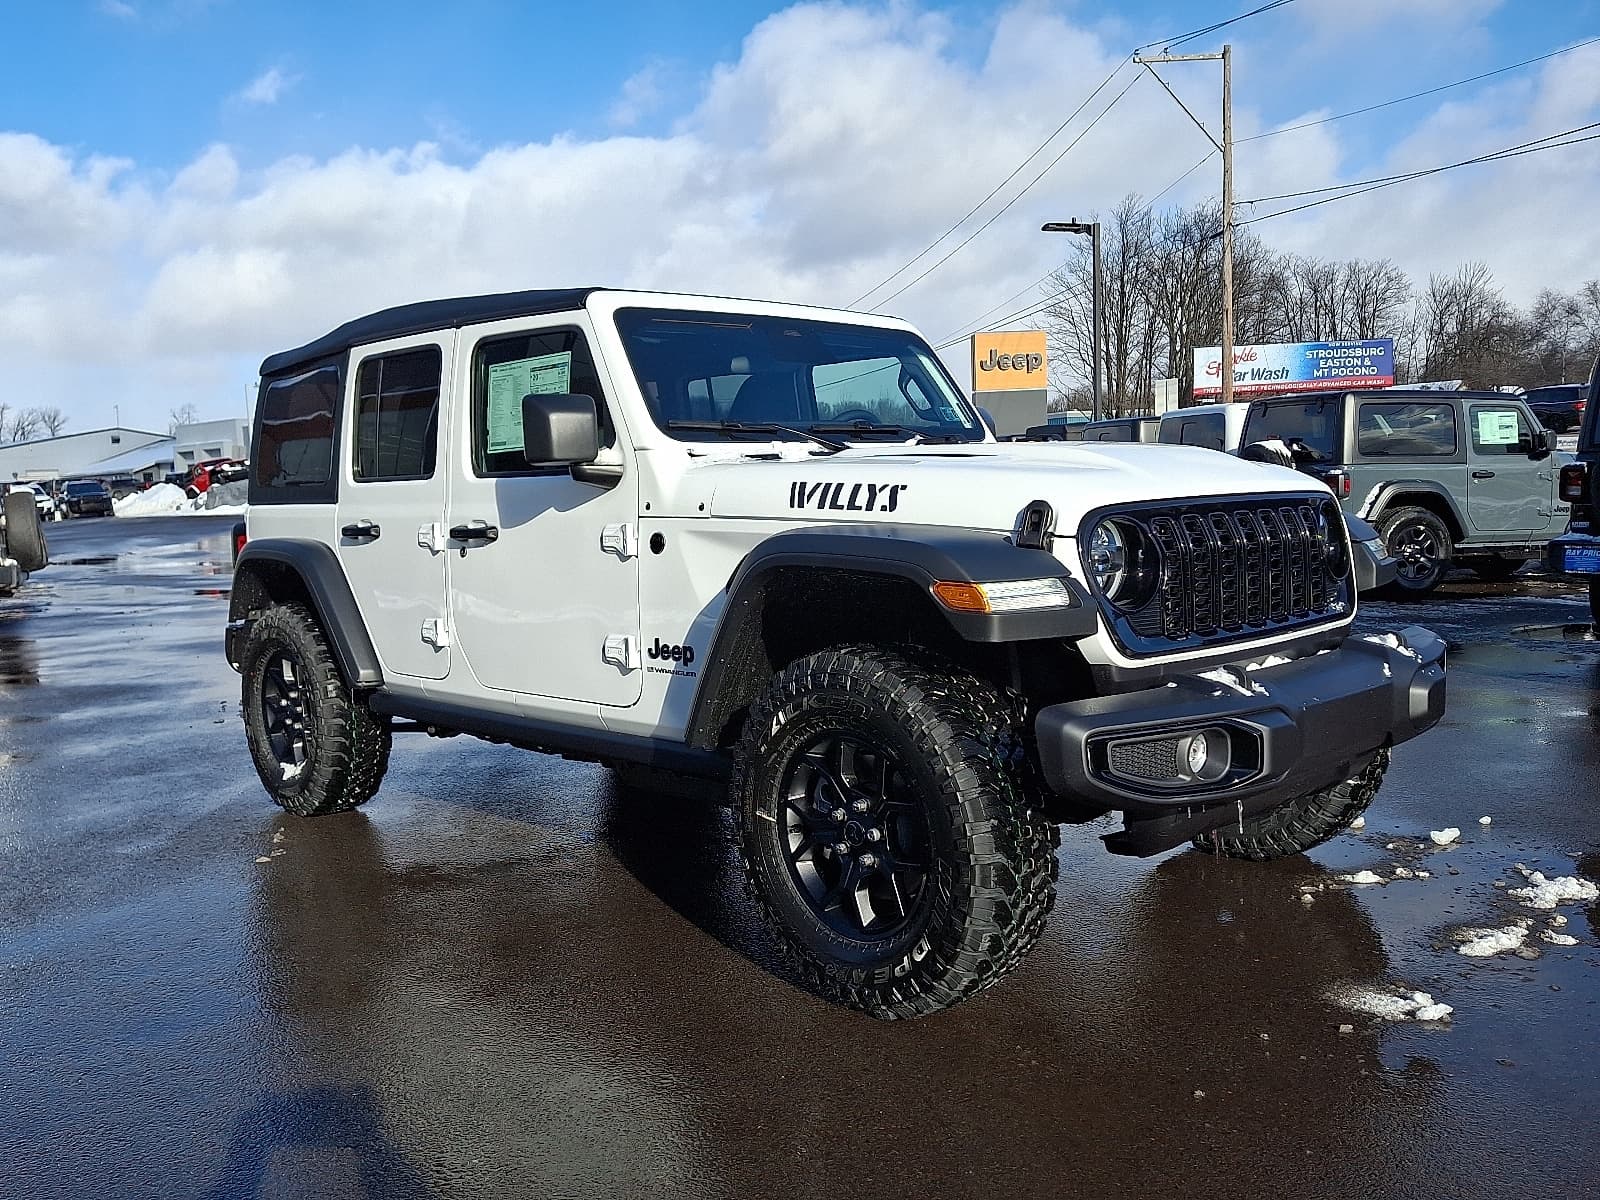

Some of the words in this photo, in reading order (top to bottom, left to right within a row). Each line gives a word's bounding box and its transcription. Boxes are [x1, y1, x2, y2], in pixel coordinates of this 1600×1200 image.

[1306, 347, 1385, 359] STROUDSBURG
[980, 348, 1043, 374] Jeep
[1319, 358, 1362, 368] EASTON
[1364, 357, 1372, 366] &
[1251, 366, 1290, 381] Wash
[1313, 368, 1329, 378] MT
[1331, 366, 1378, 377] POCONO
[1261, 382, 1317, 391] TECHNOLOGICALLY
[1367, 378, 1385, 386] WASH
[789, 481, 908, 513] WILLYS
[1554, 504, 1570, 514] Jeep
[647, 637, 695, 667] Jeep
